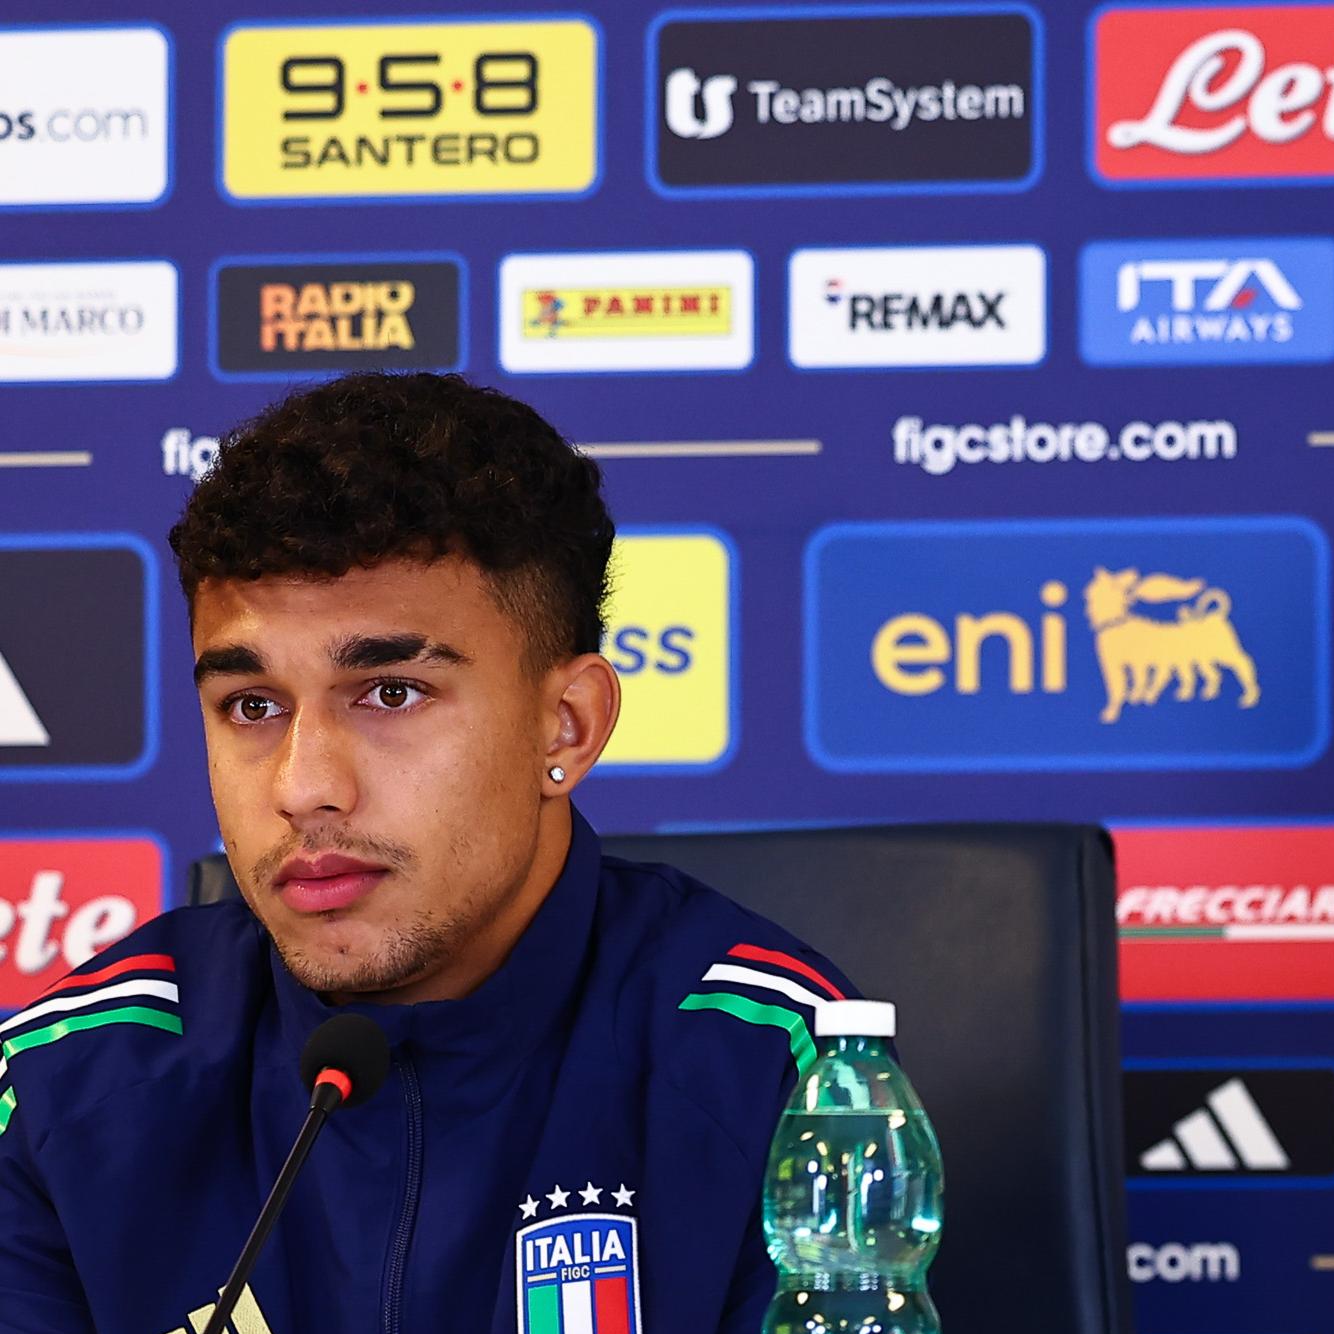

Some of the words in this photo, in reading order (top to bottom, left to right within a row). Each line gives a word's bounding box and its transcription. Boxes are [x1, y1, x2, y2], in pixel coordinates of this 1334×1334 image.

[748, 78, 1025, 130] TeamSystem
[281, 132, 541, 169] SANTERO
[260, 280, 416, 318] RADIO
[1116, 259, 1302, 312] ITA
[21, 306, 146, 337] MARCO
[583, 292, 721, 319] PANINI
[260, 316, 416, 352] ITALIA
[1131, 317, 1293, 344] AIRWAYS
[893, 416, 1238, 474] figcstore.com
[872, 581, 1067, 696] eni
[525, 1228, 626, 1272] ITALIA
[561, 1265, 591, 1282] FIGC
